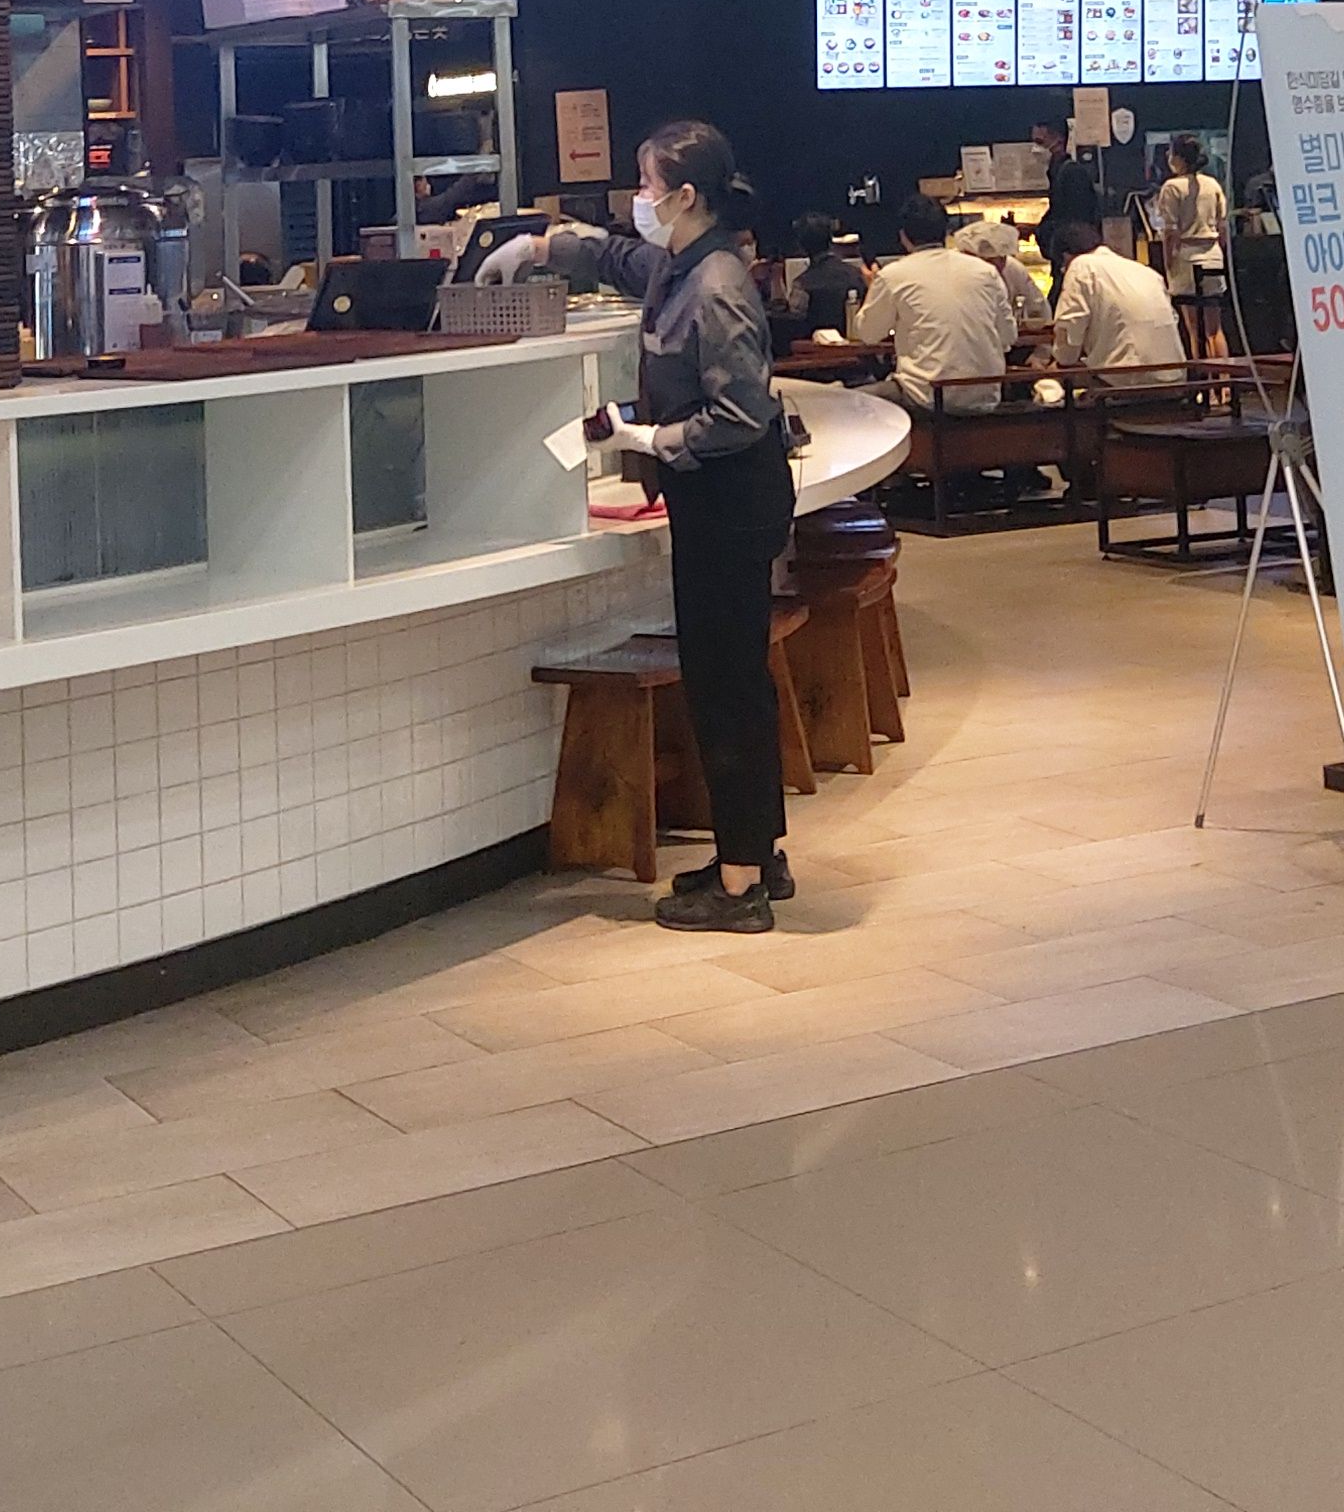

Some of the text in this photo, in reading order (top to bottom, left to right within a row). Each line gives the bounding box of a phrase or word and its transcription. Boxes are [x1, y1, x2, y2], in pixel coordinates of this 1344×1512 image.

[1286, 70, 1340, 90] 한식미담길
[1292, 94, 1335, 114] 영수증을
[1292, 182, 1341, 225] 밀크
